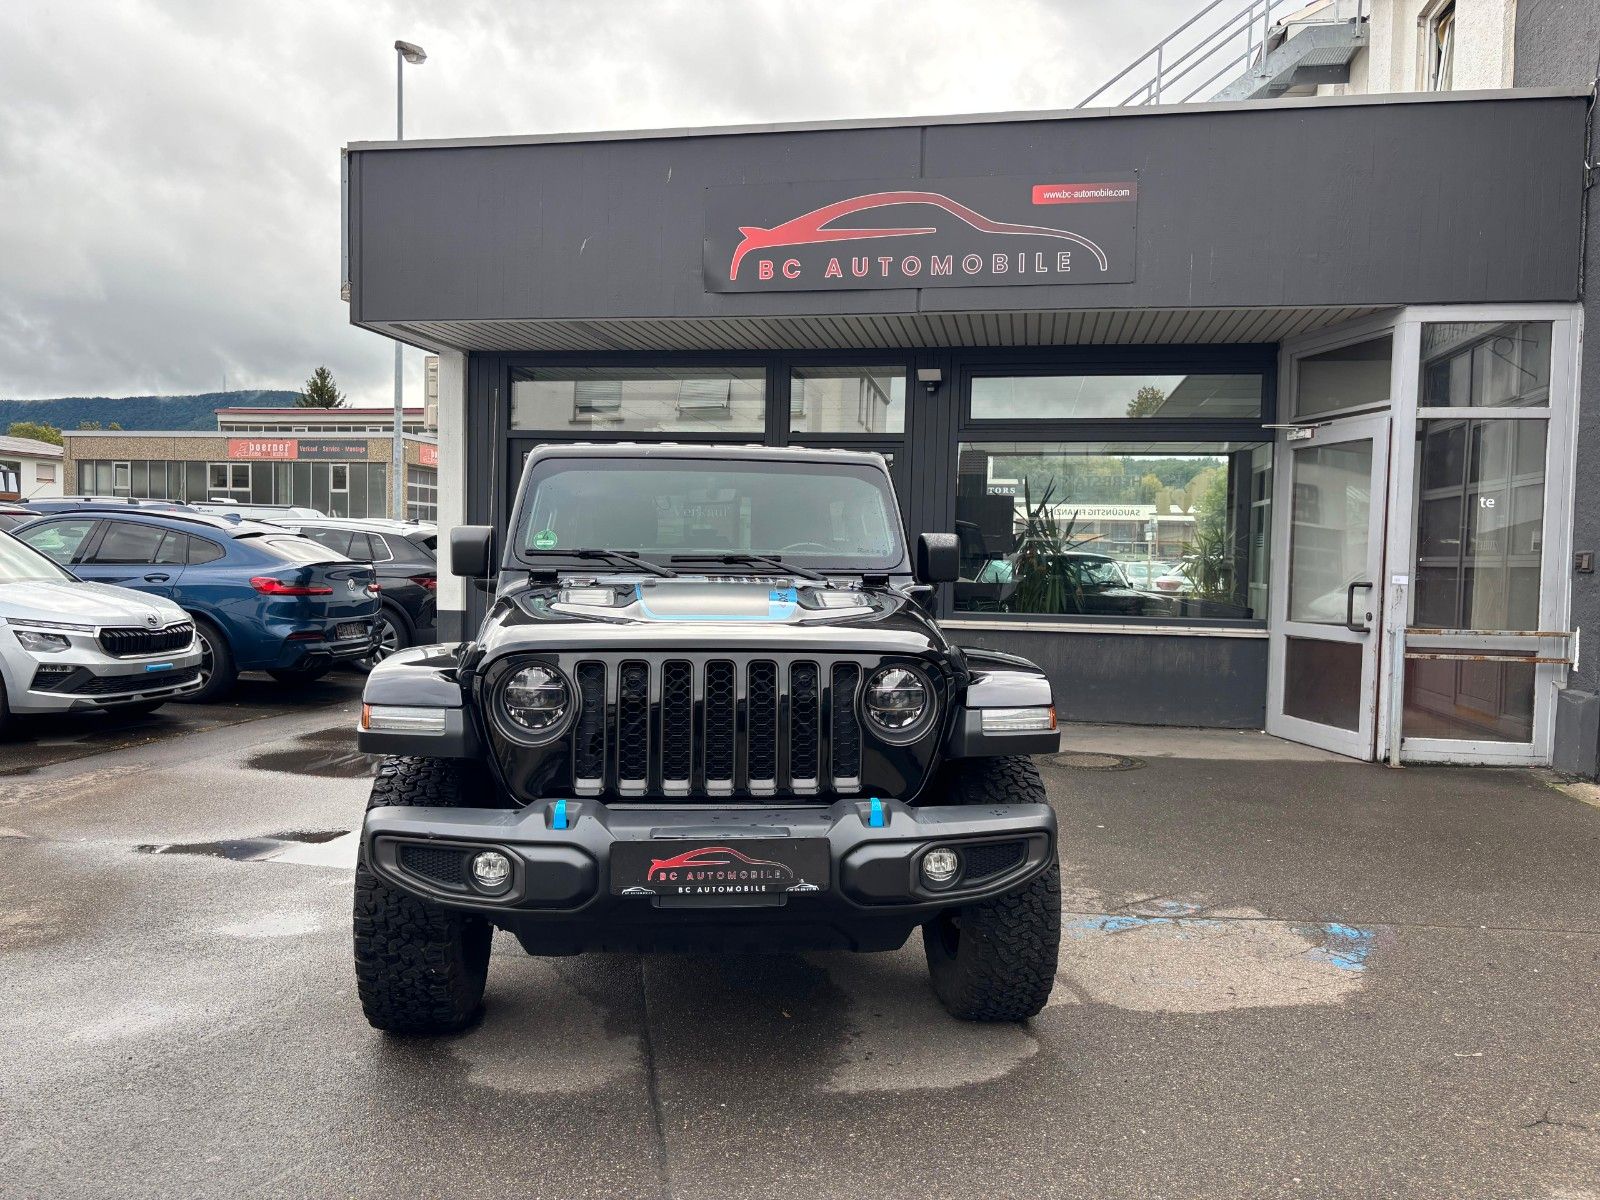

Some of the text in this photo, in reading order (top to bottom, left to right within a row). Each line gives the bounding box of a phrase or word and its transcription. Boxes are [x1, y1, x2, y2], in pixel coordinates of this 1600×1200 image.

[1043, 188, 1130, 199] www.bc-automobile.com
[758, 251, 1072, 281] BC AUTOMOBILE
[1480, 496, 1495, 508] te
[659, 870, 781, 881] BC AUTOMOBILE
[678, 885, 767, 894] BC AUTOMOBILE
